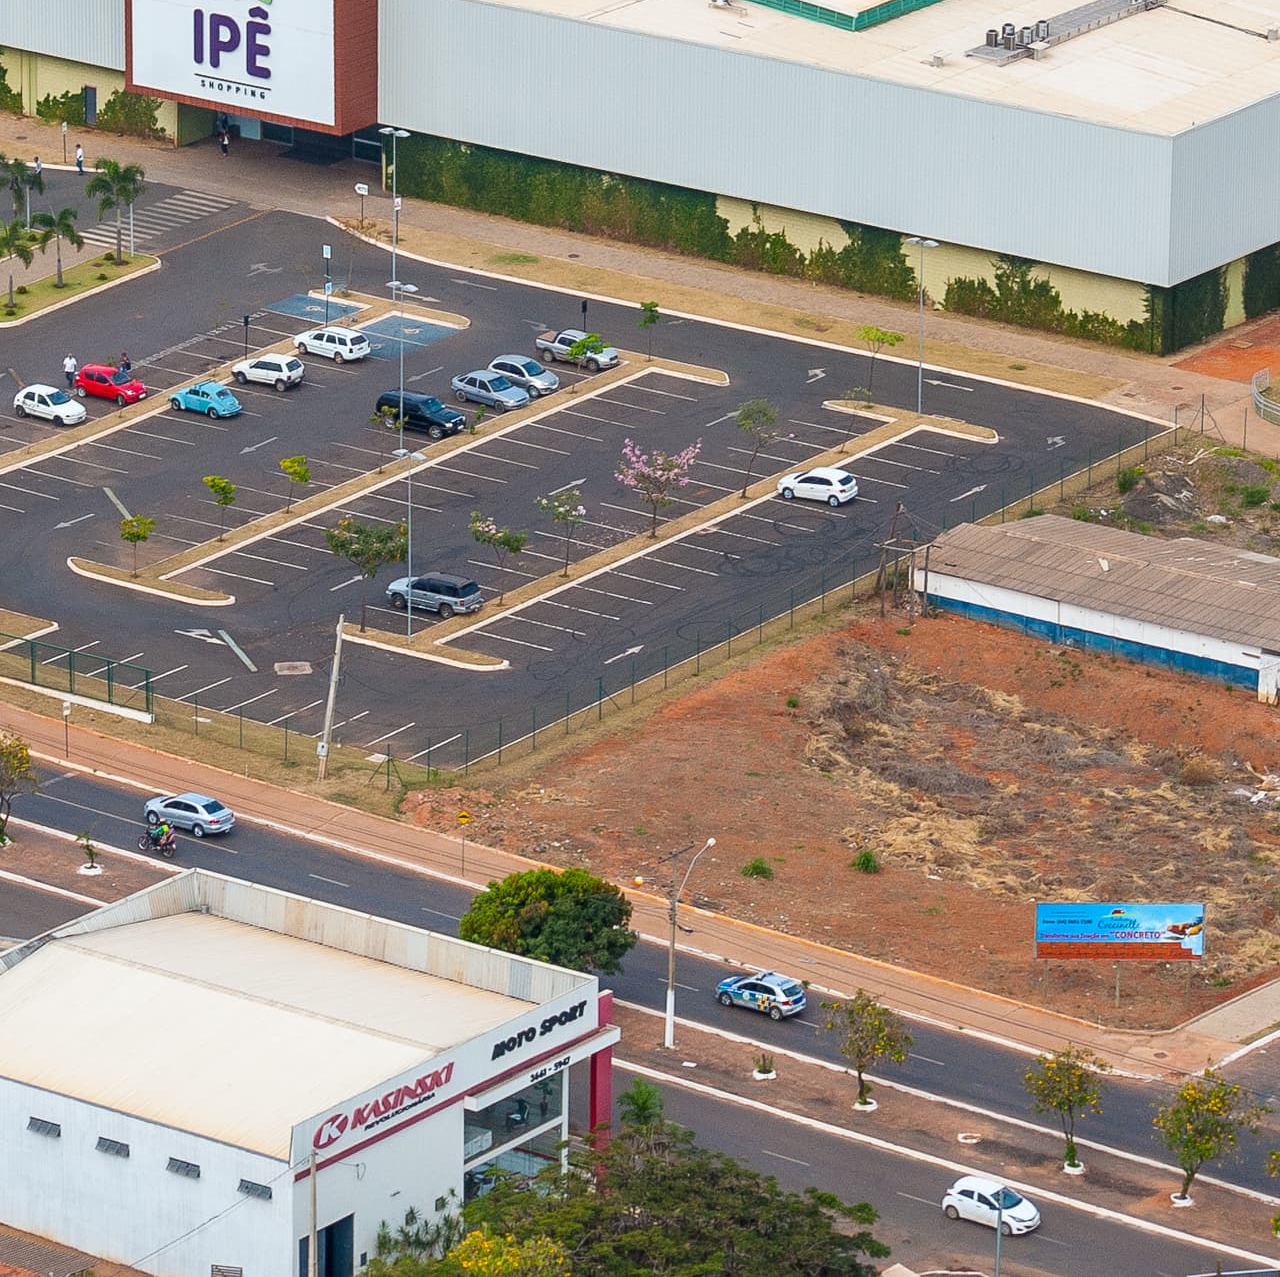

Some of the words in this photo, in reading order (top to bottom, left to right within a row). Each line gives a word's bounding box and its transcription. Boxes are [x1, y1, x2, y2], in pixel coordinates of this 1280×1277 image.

[193, 6, 271, 79] IPÊ
[200, 79, 266, 100] SHOPPING
[491, 1026, 537, 1060] MOTO
[539, 1000, 588, 1036] SPORT
[350, 1062, 455, 1130] KASINSKI
